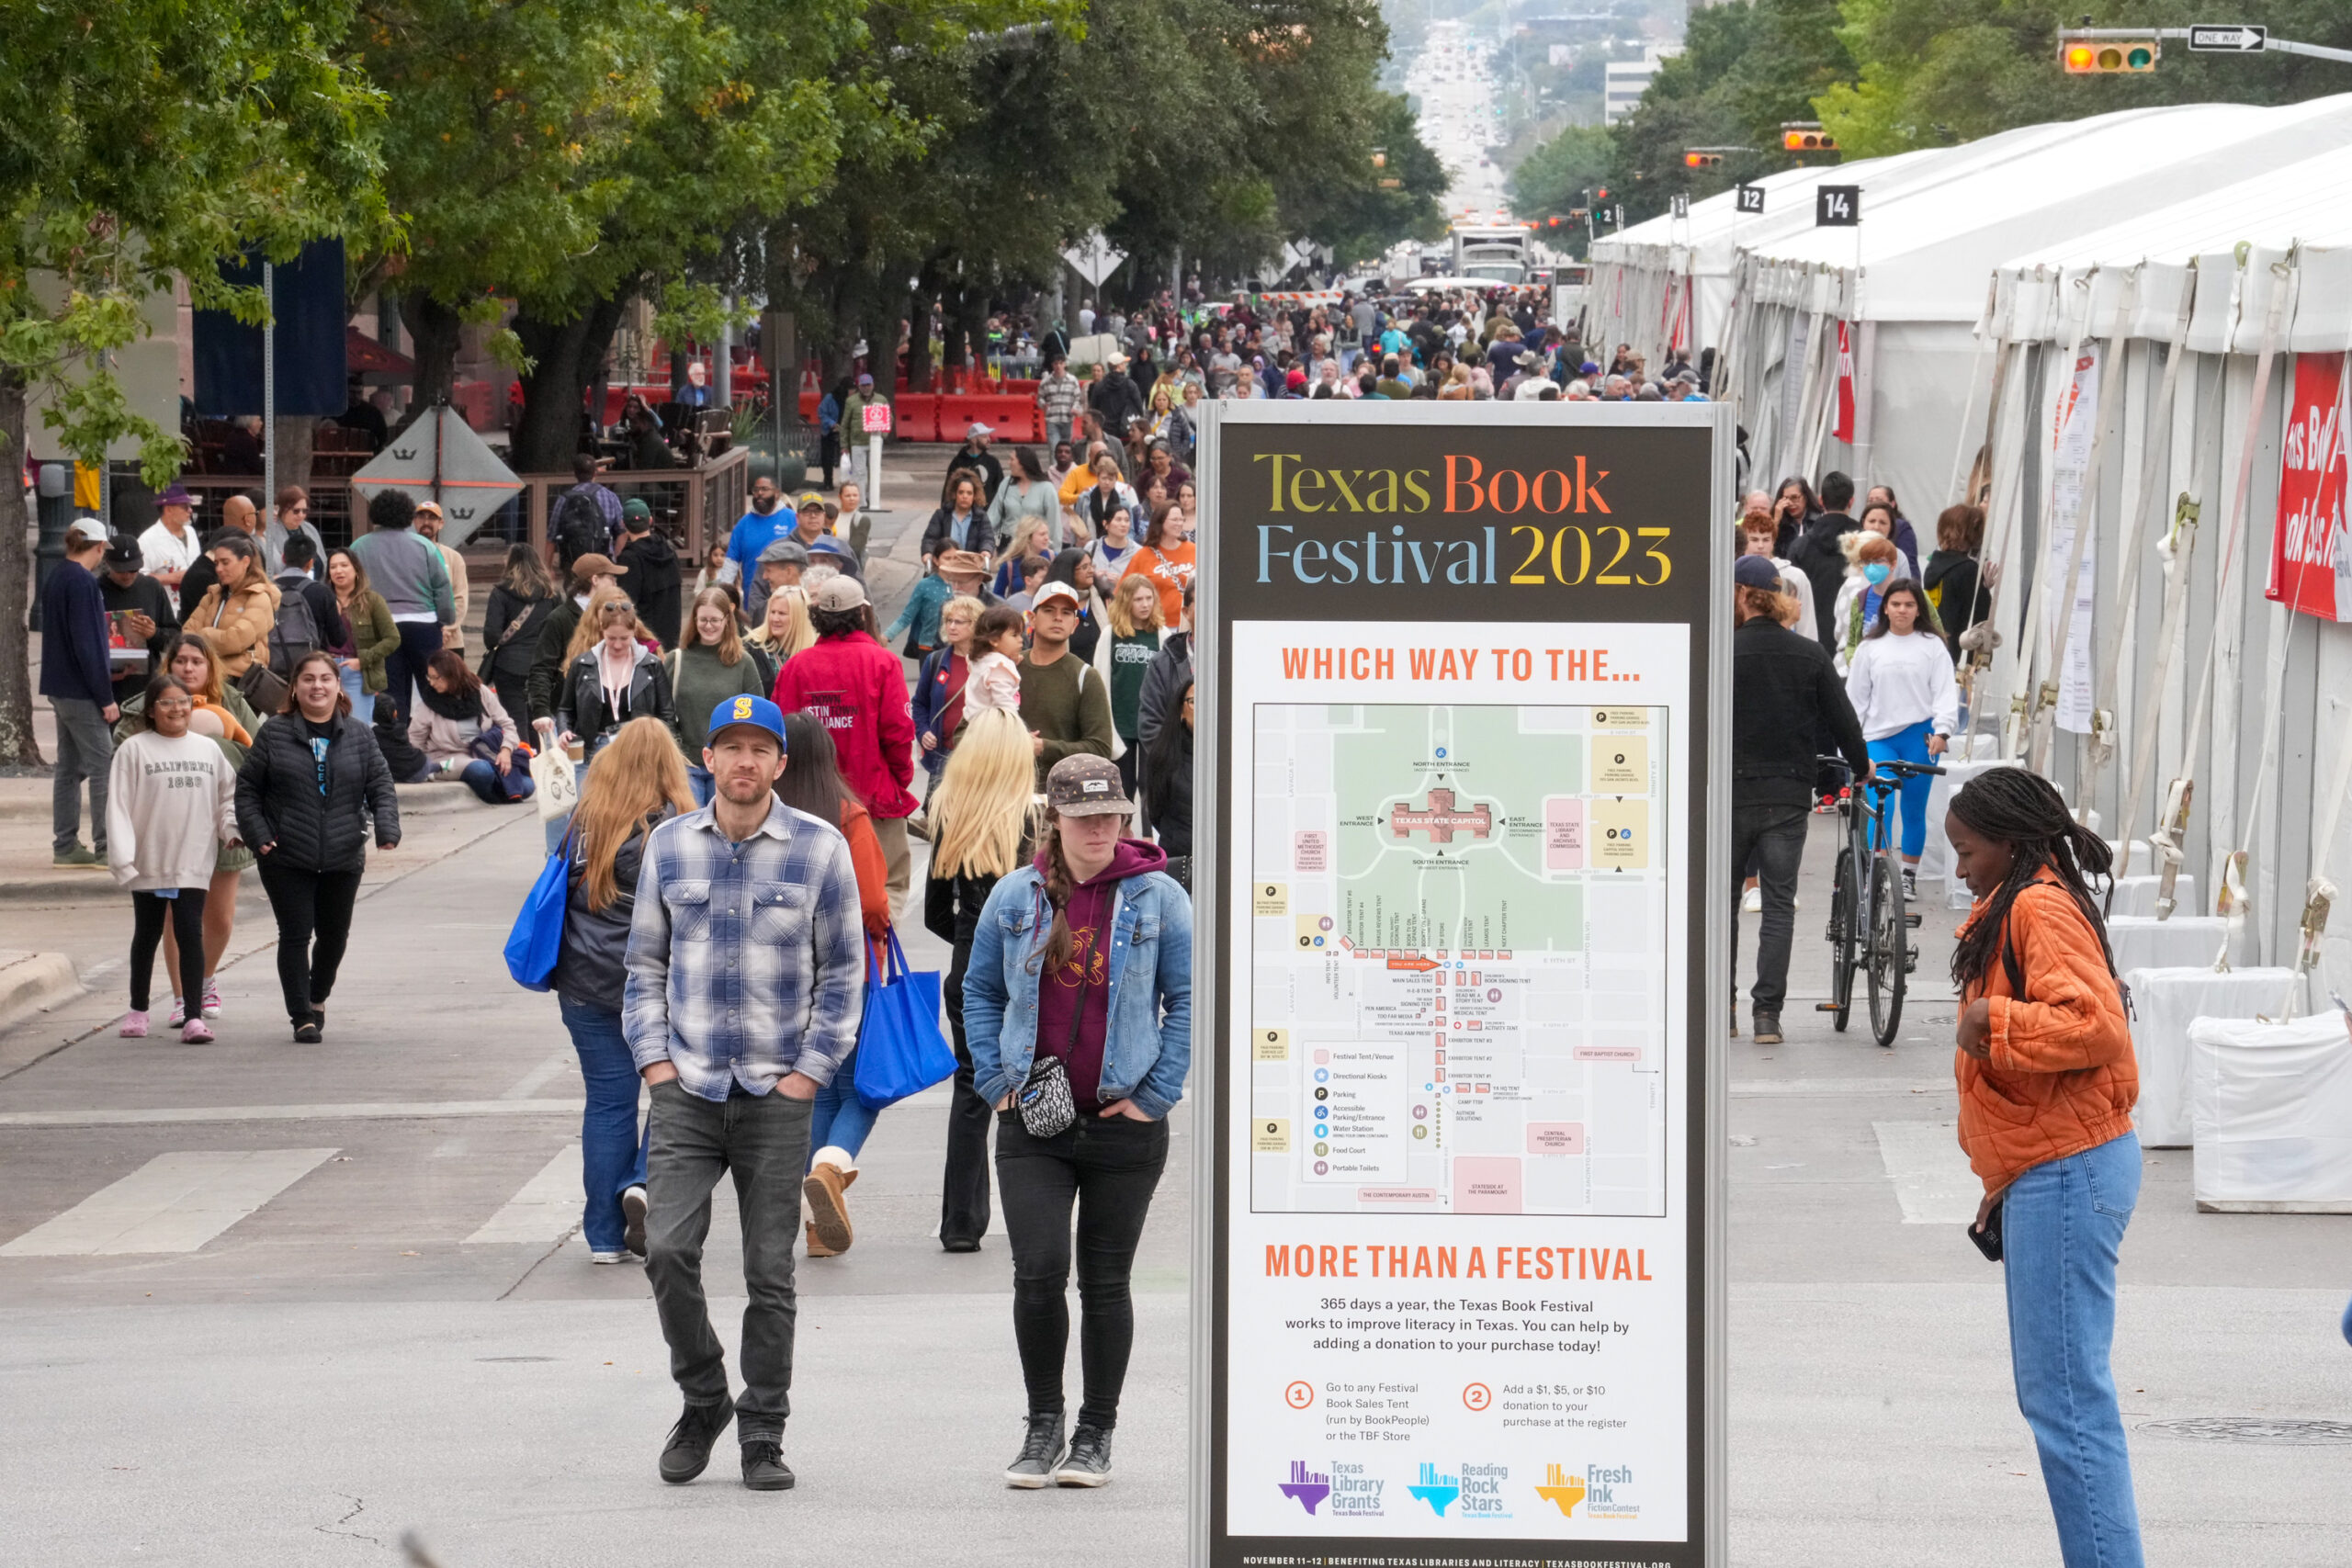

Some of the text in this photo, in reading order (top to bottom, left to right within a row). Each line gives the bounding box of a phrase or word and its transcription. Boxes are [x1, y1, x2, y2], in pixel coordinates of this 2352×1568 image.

[2198, 33, 2242, 43] ONE WAY
[1743, 190, 1760, 208] 12
[1826, 194, 1849, 219] 14
[1603, 209, 1611, 222] 2
[1254, 455, 1611, 513] Texas Book
[1257, 525, 1671, 585] Festival 2023
[1283, 648, 1640, 682] WHICH WAY TO THE...
[733, 697, 752, 719] S
[144, 761, 214, 775] CALIFORNIA
[168, 776, 202, 788] 1850
[1333, 1091, 1356, 1100] Parking
[1266, 1245, 1652, 1280] MORE THAN A FESTIVAL
[1321, 1298, 1346, 1309] 365
[1351, 1298, 1381, 1312] days
[1397, 1302, 1429, 1313] year,
[1433, 1299, 1454, 1310] the
[1459, 1300, 1497, 1311] Texas
[1502, 1300, 1535, 1311] Book
[1541, 1301, 1592, 1312] Festival
[1286, 1317, 1325, 1328] works
[1329, 1319, 1342, 1328] to
[1348, 1318, 1400, 1332] improve
[1406, 1318, 1455, 1333] literacy
[1460, 1319, 1471, 1330] in
[1476, 1319, 1517, 1330] Texas.
[1522, 1320, 1545, 1331] You
[1580, 1321, 1609, 1335] help
[1614, 1321, 1629, 1335] by
[1314, 1337, 1359, 1351] adding
[1375, 1338, 1435, 1349] donation
[1440, 1339, 1453, 1349] to
[1457, 1342, 1487, 1352] your
[1492, 1339, 1554, 1353] purchase
[1558, 1340, 1600, 1354] today!
[1327, 1382, 1418, 1394] Go to any Festival
[1503, 1385, 1523, 1393] Add
[1536, 1384, 1550, 1395] $1,
[1555, 1385, 1569, 1395] $5,
[1587, 1385, 1605, 1395] $10
[1295, 1389, 1306, 1402] 1
[1472, 1391, 1483, 1403] 2
[1327, 1399, 1408, 1408] Book Sales Tent
[1503, 1401, 1548, 1410] donation
[1566, 1404, 1588, 1413] your
[1327, 1415, 1429, 1427] (run by BookPeople)
[1503, 1417, 1626, 1429] purchase at the register
[1340, 1431, 1356, 1440] the
[1360, 1431, 1379, 1440] TBF
[1383, 1431, 1410, 1440] Store
[1331, 1461, 1363, 1473] Texas
[1462, 1463, 1508, 1479] Reading
[1588, 1464, 1632, 1483] Fresh
[1332, 1475, 1385, 1495] Library
[1462, 1477, 1498, 1494] Rock
[1588, 1484, 1613, 1503] Ink
[1332, 1493, 1381, 1509] Grants
[1462, 1495, 1503, 1511] Stars
[1588, 1504, 1640, 1513] Fiction Contest
[1243, 1556, 1295, 1565] NOVEMBER
